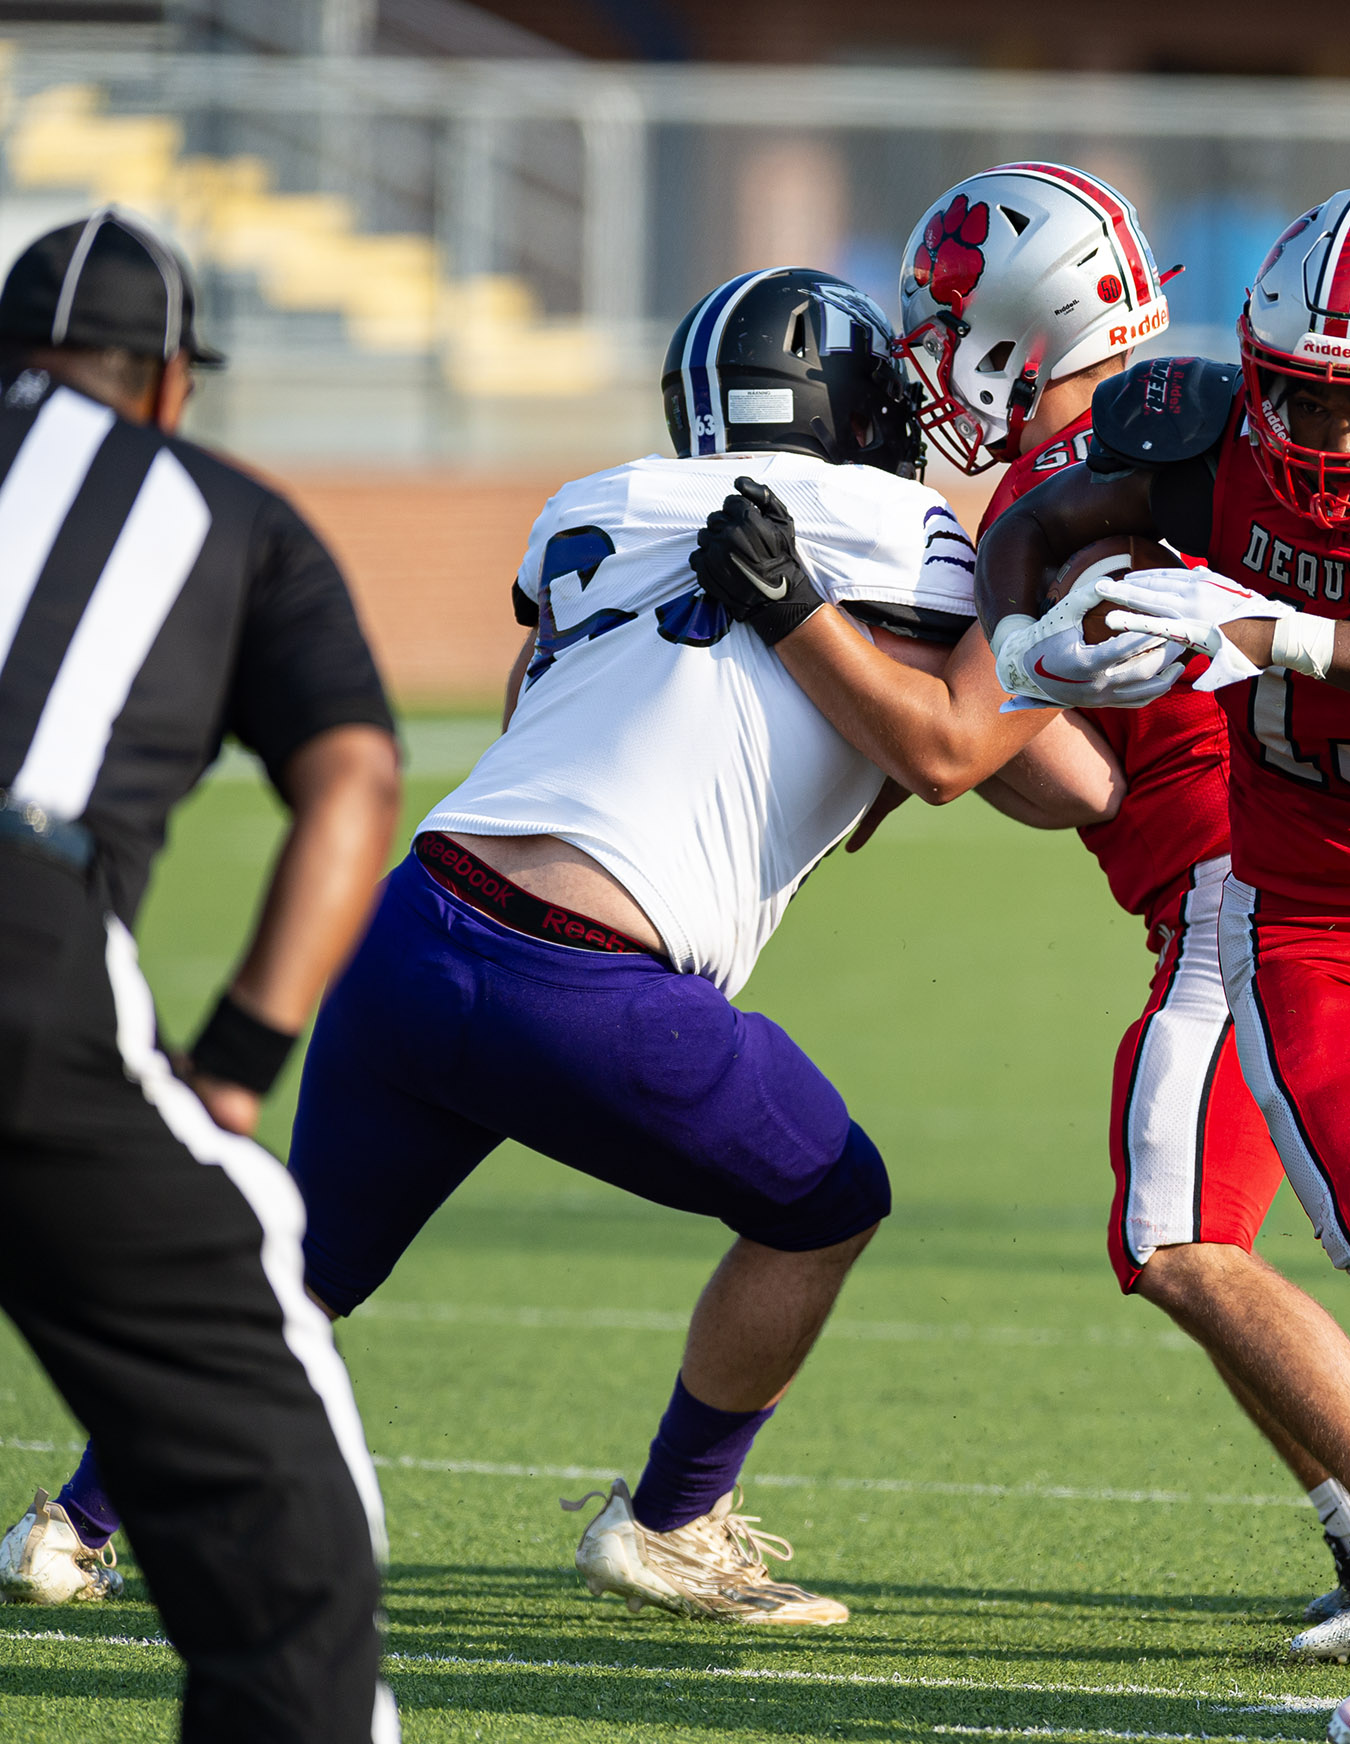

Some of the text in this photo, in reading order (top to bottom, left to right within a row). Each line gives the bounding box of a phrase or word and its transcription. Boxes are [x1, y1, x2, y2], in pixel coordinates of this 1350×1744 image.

[1100, 277, 1119, 301] 50
[1109, 307, 1168, 346] Ridde
[695, 414, 716, 437] 63
[1261, 399, 1292, 444] Ridde
